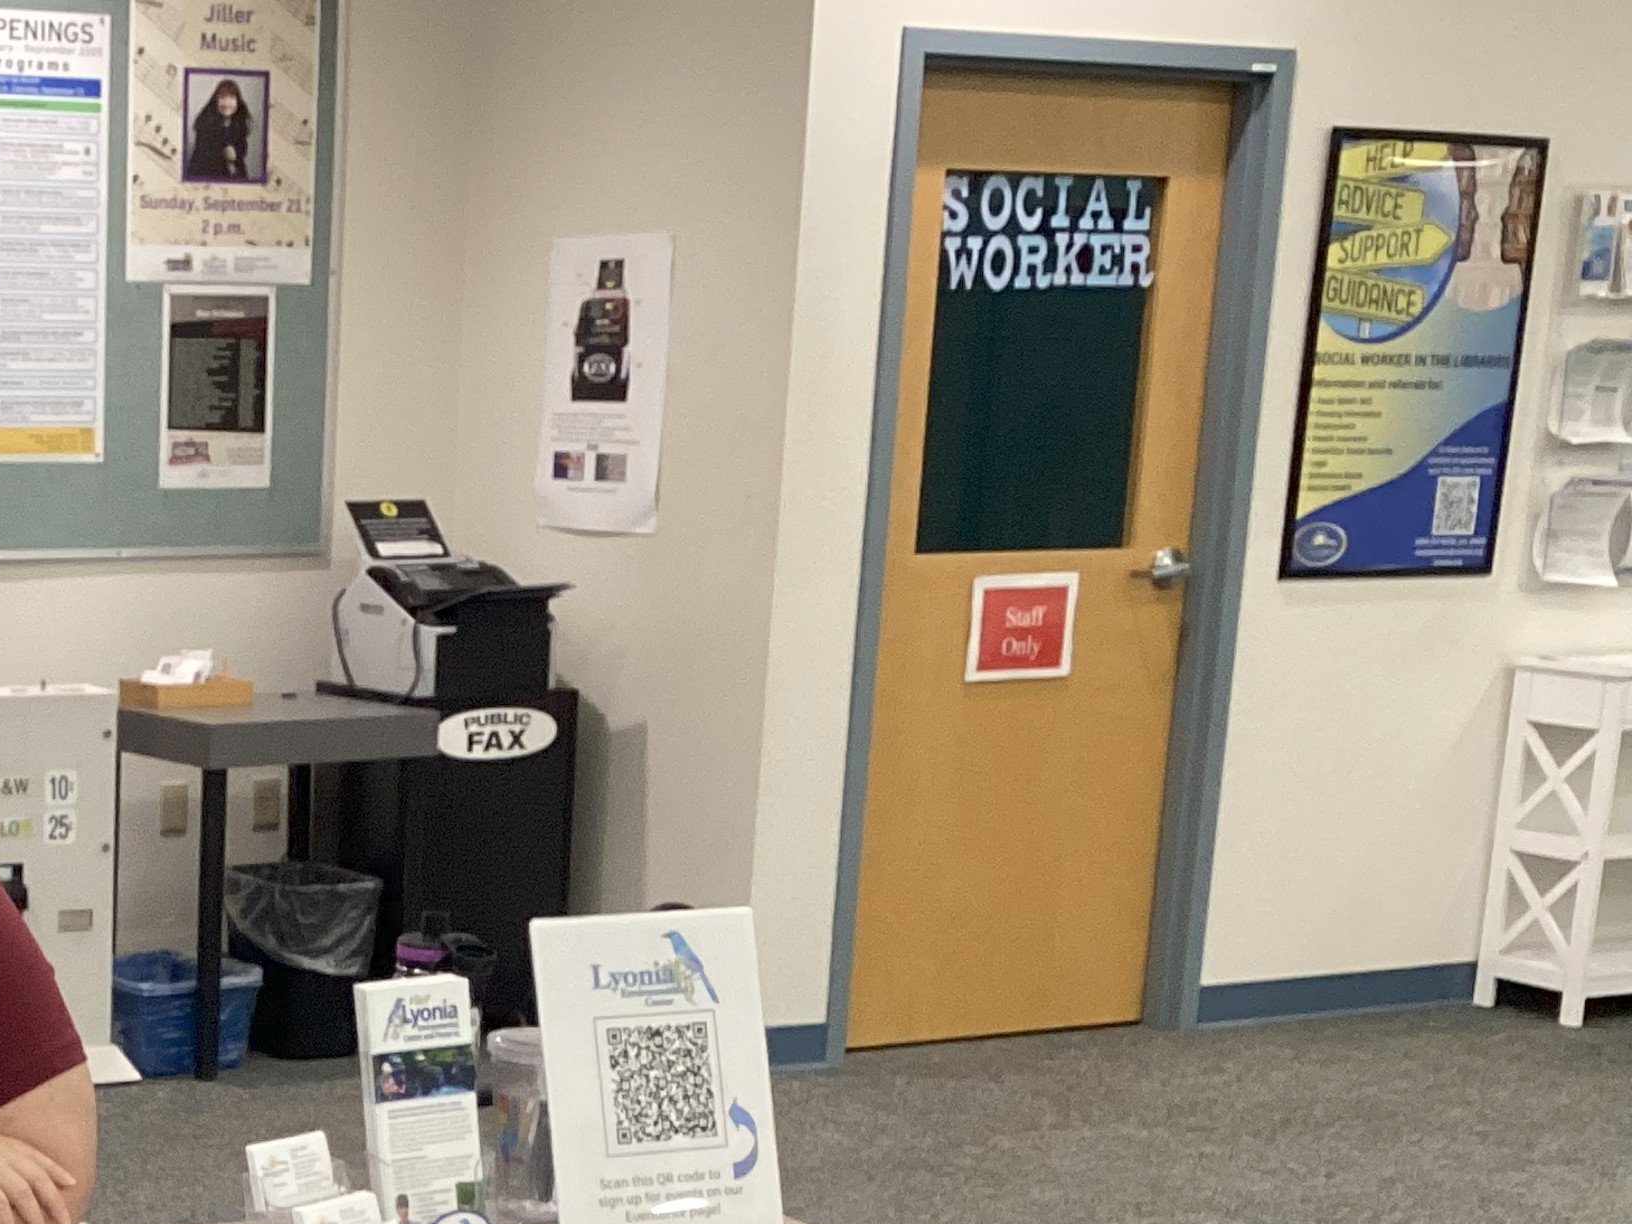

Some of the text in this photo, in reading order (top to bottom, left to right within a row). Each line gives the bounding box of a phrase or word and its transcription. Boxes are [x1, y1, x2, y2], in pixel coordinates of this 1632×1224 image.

[203, 3, 255, 23] Jiller
[200, 32, 256, 53] Music
[1366, 140, 1414, 173] HELP
[203, 196, 282, 215] September
[942, 174, 1151, 232] SOCIAL
[1337, 183, 1406, 221] ADVICE
[202, 219, 209, 234] 2
[1337, 228, 1423, 265] SUPPORT
[944, 233, 1155, 292] WORKER
[1326, 275, 1417, 316] GUIDANCE
[1005, 605, 1047, 628] Staff
[1001, 634, 1041, 660] Only
[464, 713, 532, 730] PUBLIC
[467, 728, 527, 752] FAX
[591, 960, 674, 992] Lyonia
[402, 998, 458, 1029] Lyonia
[600, 1169, 720, 1190] Scan this QR code to
[598, 1195, 623, 1210] sign
[627, 1194, 642, 1206] up
[645, 1191, 661, 1203] for
[706, 1187, 721, 1198] on
[724, 1186, 743, 1196] our
